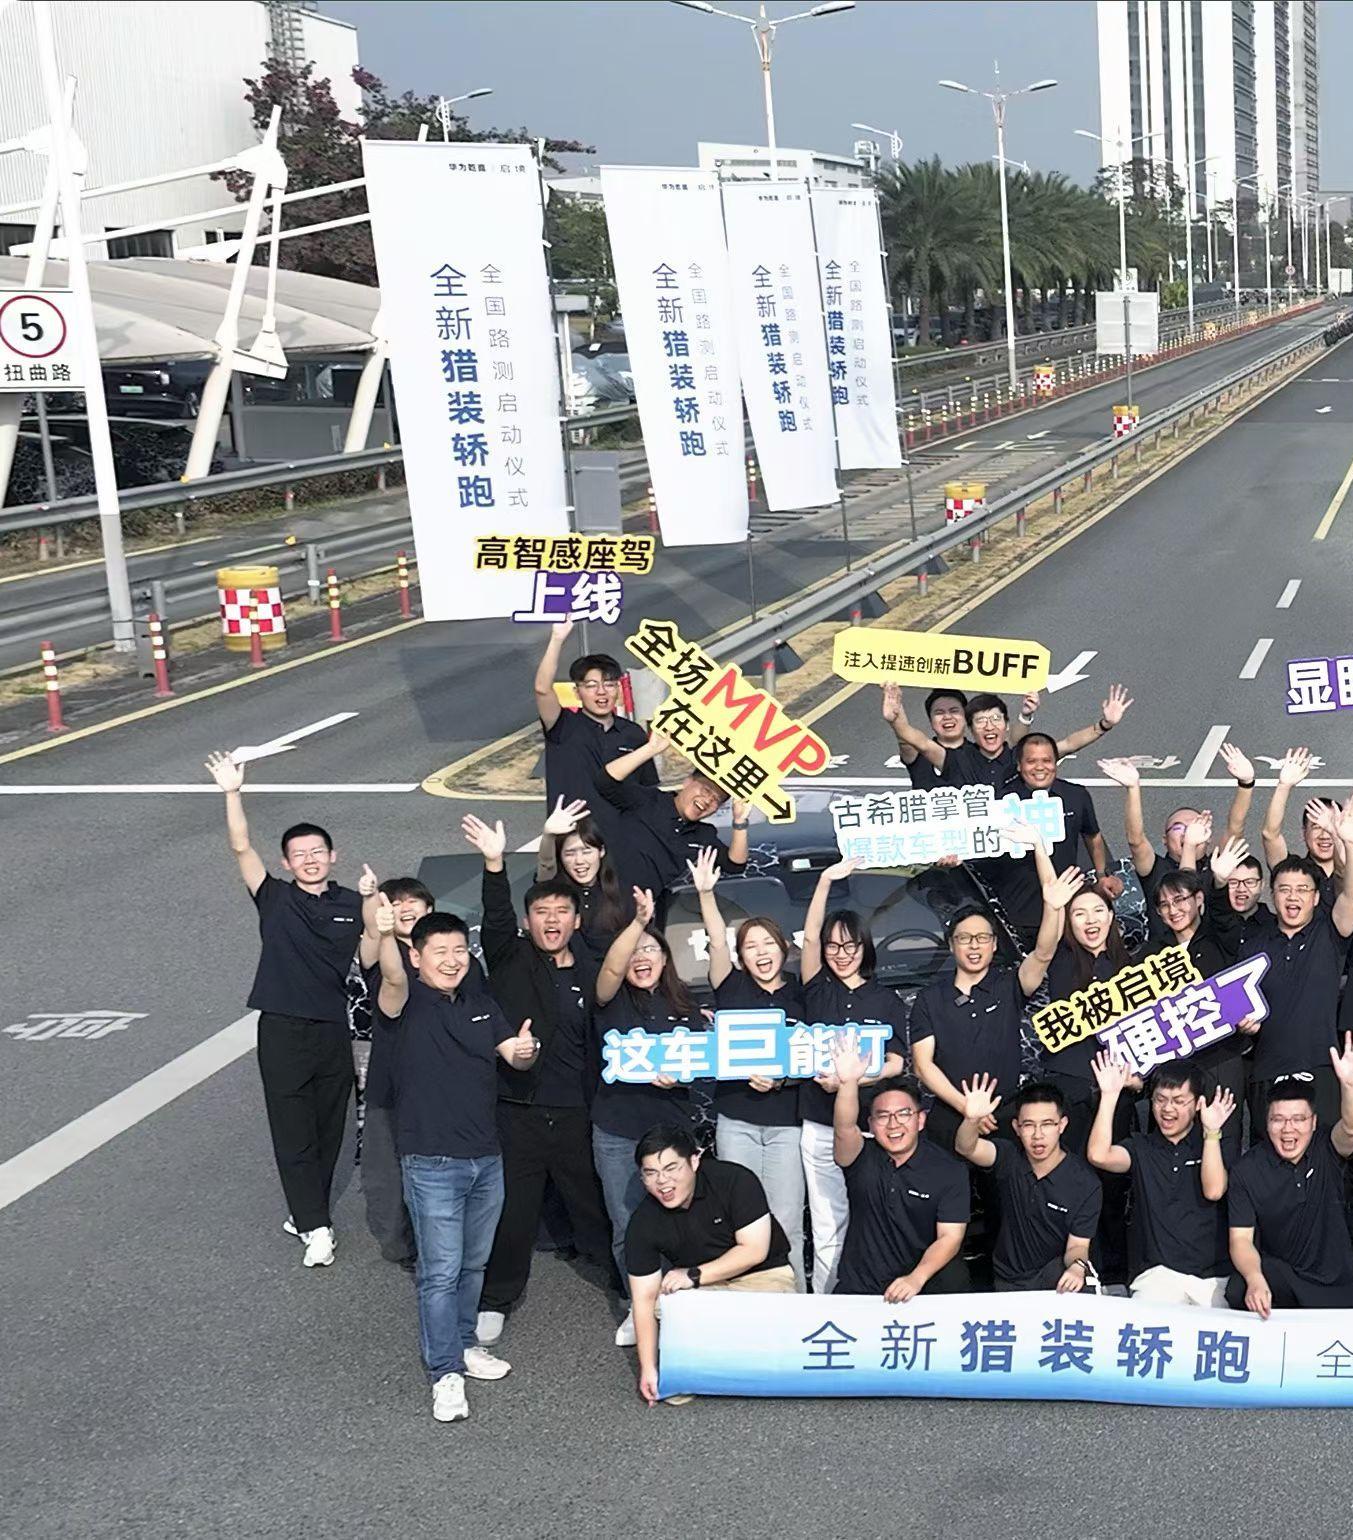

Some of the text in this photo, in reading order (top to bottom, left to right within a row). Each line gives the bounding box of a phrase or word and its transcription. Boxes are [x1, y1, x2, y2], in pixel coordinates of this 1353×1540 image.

[4, 363, 72, 382] 扭曲路
[20, 312, 44, 342] 5
[652, 263, 707, 457] 全新猎装轿跑
[688, 262, 729, 457] 全国路测启动仪式
[752, 264, 798, 433] 全新猎装轿跑
[825, 260, 849, 405] 全新猎装轿跑
[430, 263, 495, 508] 全新猎装轿跑
[480, 263, 529, 508] 全国路测启动仪式
[476, 536, 651, 571] 高智感座驾
[513, 572, 622, 624] 上线
[630, 624, 827, 772] 全场MVP
[655, 698, 769, 803] 在这里
[834, 788, 990, 830] 古希腊掌管
[843, 825, 1001, 863] 爆款车型的
[1037, 950, 1196, 1049] 我被启境
[1100, 955, 1269, 1076] 硬控了
[801, 1318, 1251, 1385] 全新猎装轿跑
